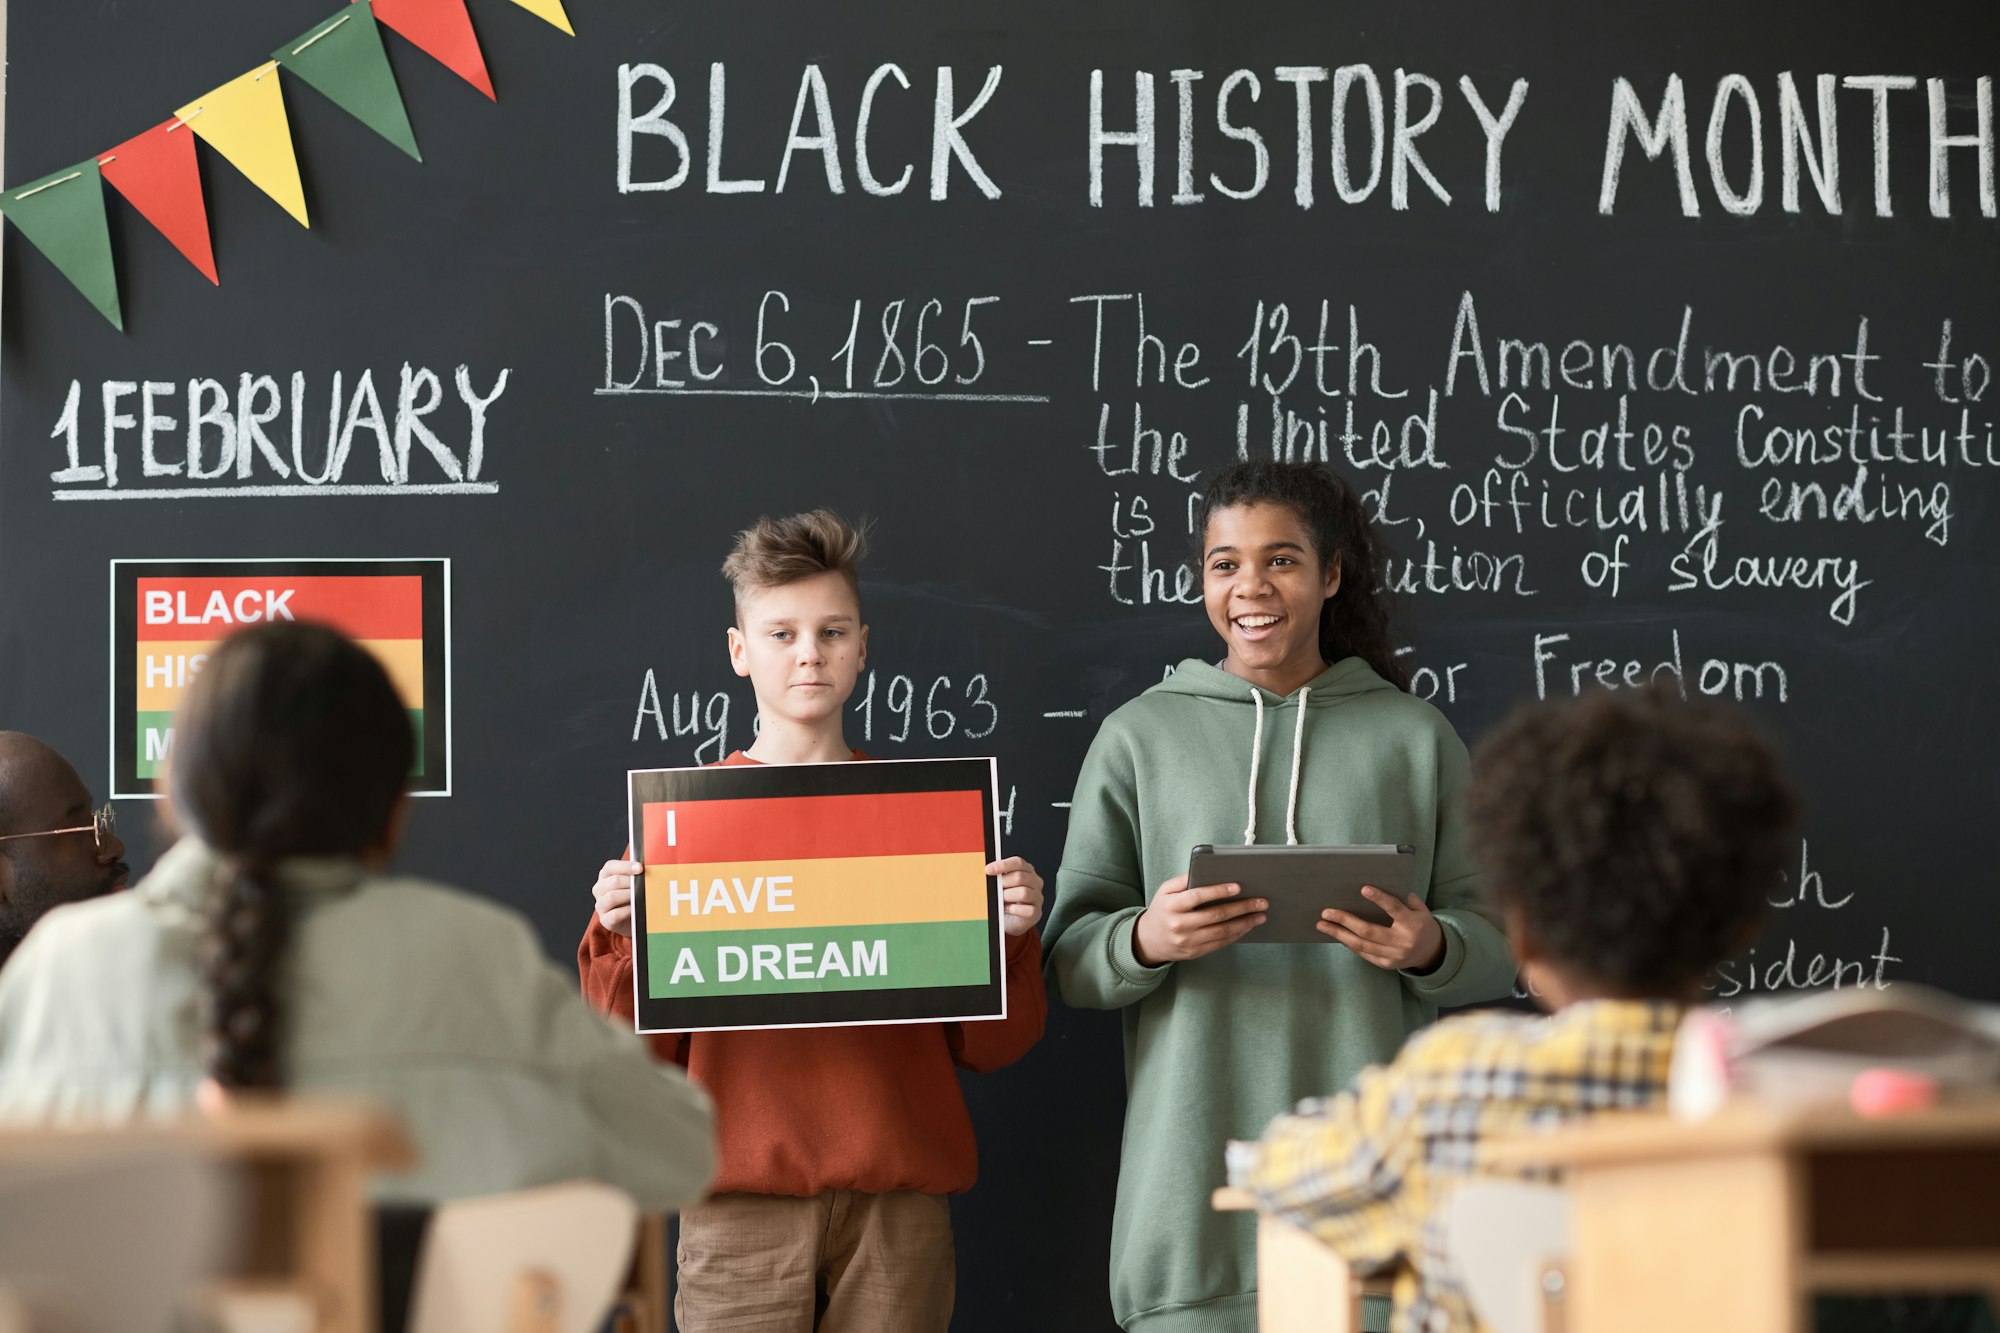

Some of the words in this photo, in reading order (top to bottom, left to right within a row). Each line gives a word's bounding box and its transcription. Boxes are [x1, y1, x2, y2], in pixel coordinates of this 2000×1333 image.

[617, 62, 1003, 201] BLACK
[1088, 62, 1529, 212] HISTORY
[1599, 71, 1998, 218] MONTH
[604, 292, 724, 392] DEC
[1069, 292, 1211, 392] The
[1236, 299, 1409, 399] 13th
[1444, 290, 1884, 403] Amendment
[1921, 317, 1991, 403] to
[1089, 401, 1202, 484] the
[1494, 393, 1695, 472] States
[1112, 491, 1155, 539] is
[1449, 468, 1726, 556] officially
[1759, 464, 1955, 546] ending
[144, 589, 296, 625] BLACK
[1580, 533, 1631, 599] of
[1667, 536, 1874, 626] slavery
[1394, 646, 1468, 704] or
[1534, 628, 1789, 704] Freedom
[631, 667, 731, 766] Aug
[854, 669, 999, 742] 1963
[666, 810, 676, 847] I
[669, 875, 796, 917] HAVE
[669, 948, 706, 985] A
[716, 940, 889, 983] DREAM
[1702, 926, 1903, 997] sident
